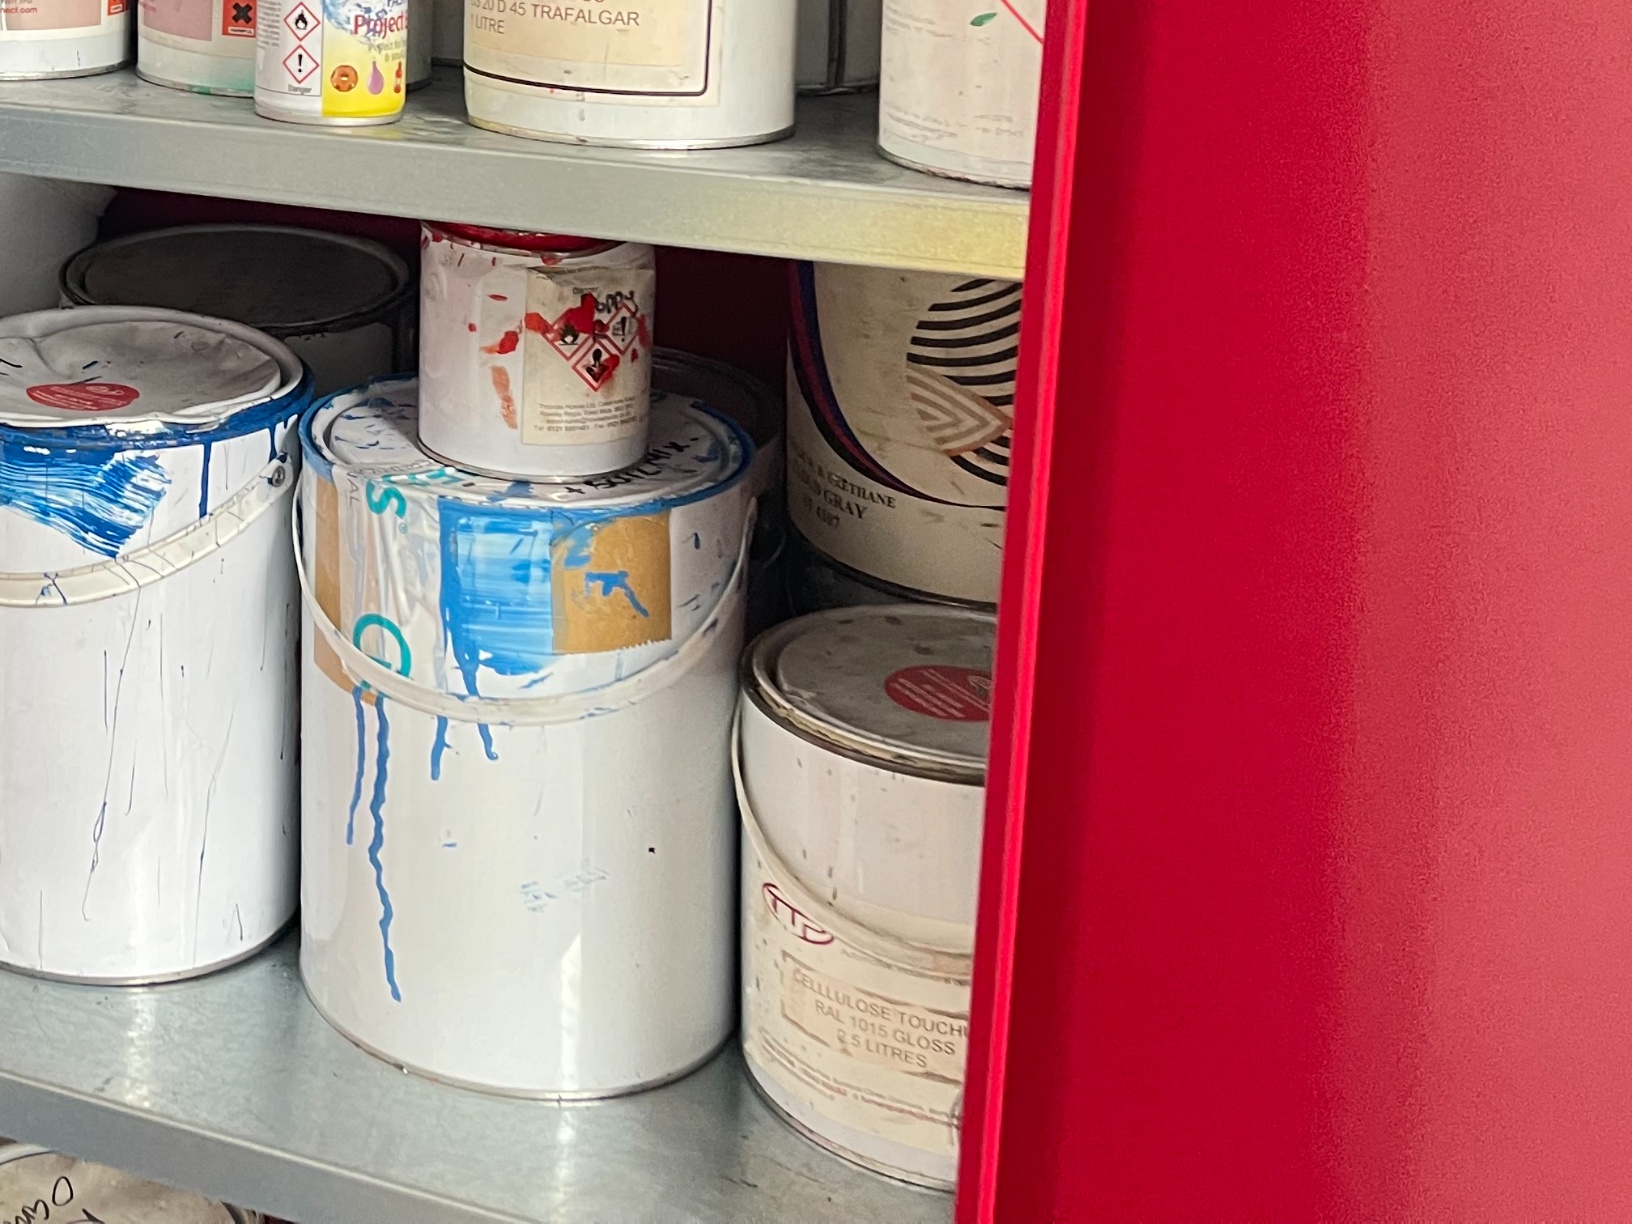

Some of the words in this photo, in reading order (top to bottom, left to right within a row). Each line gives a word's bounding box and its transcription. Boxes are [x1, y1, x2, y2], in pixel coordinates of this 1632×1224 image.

[475, 17, 504, 34] LITRE
[497, 0, 506, 13] D
[510, 2, 526, 16] 45
[531, 3, 640, 27] TRAFALGAR
[824, 490, 867, 519] GRAY
[815, 1000, 845, 1023] RAL
[851, 1016, 888, 1038] 1015
[892, 1029, 955, 1055] GLOSS
[867, 1044, 928, 1067] LITRES
